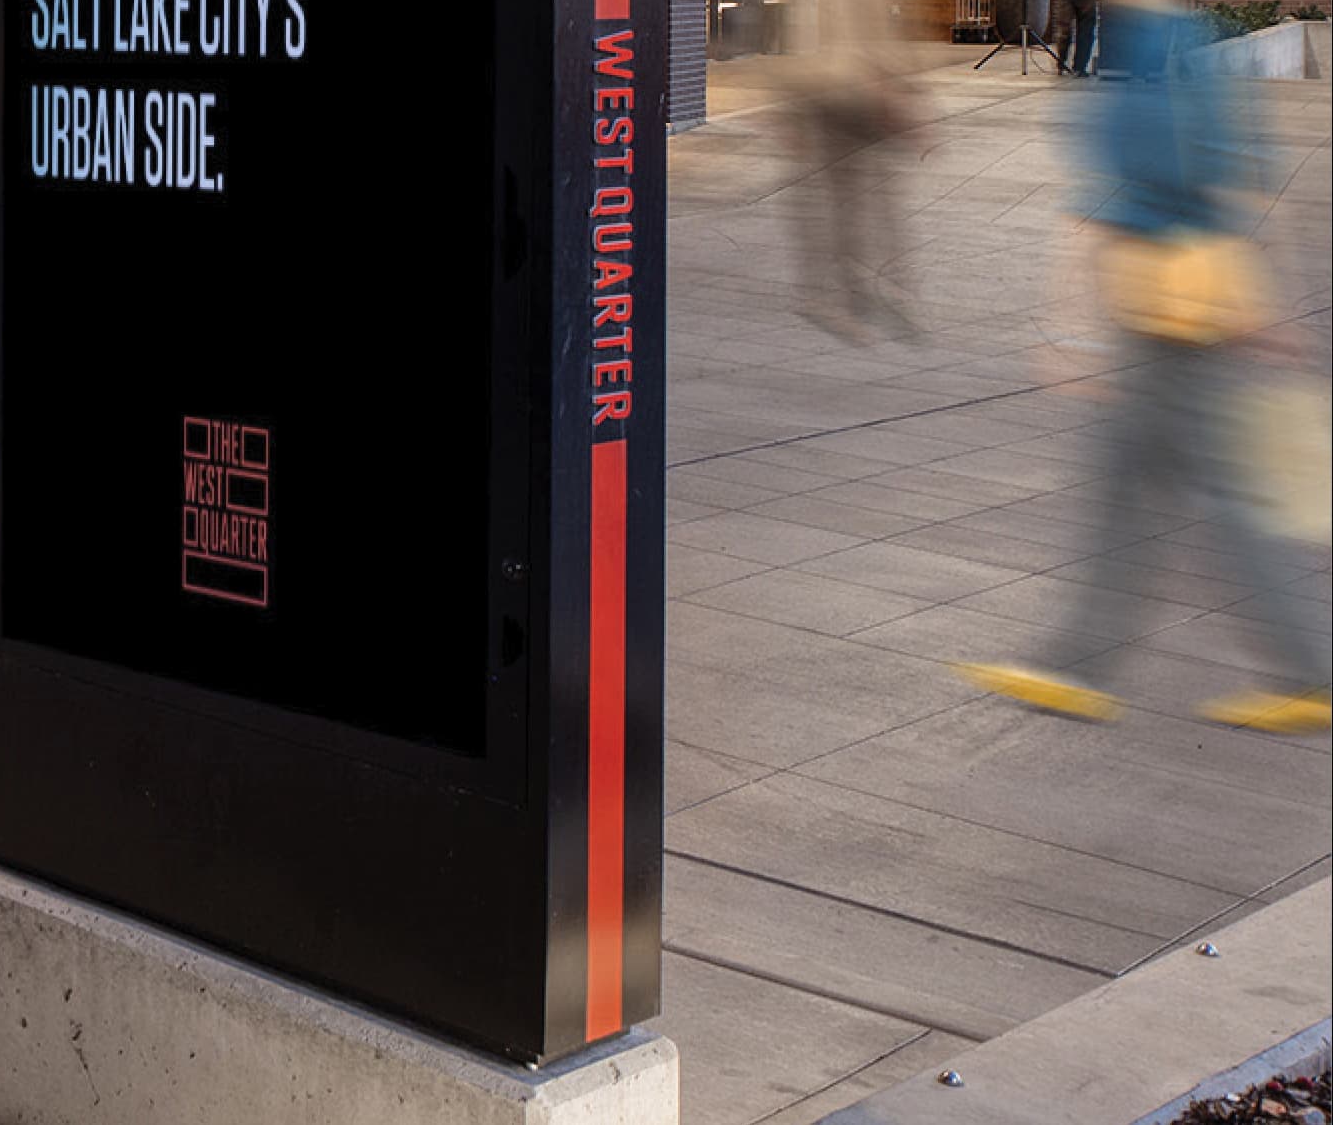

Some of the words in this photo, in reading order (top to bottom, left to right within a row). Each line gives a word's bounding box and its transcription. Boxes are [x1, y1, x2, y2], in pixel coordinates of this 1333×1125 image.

[32, 85, 135, 184] URBAN
[144, 90, 224, 192] SIDE.
[212, 421, 239, 467] THE
[183, 460, 223, 508] WEST
[199, 507, 267, 563] QUARTER
